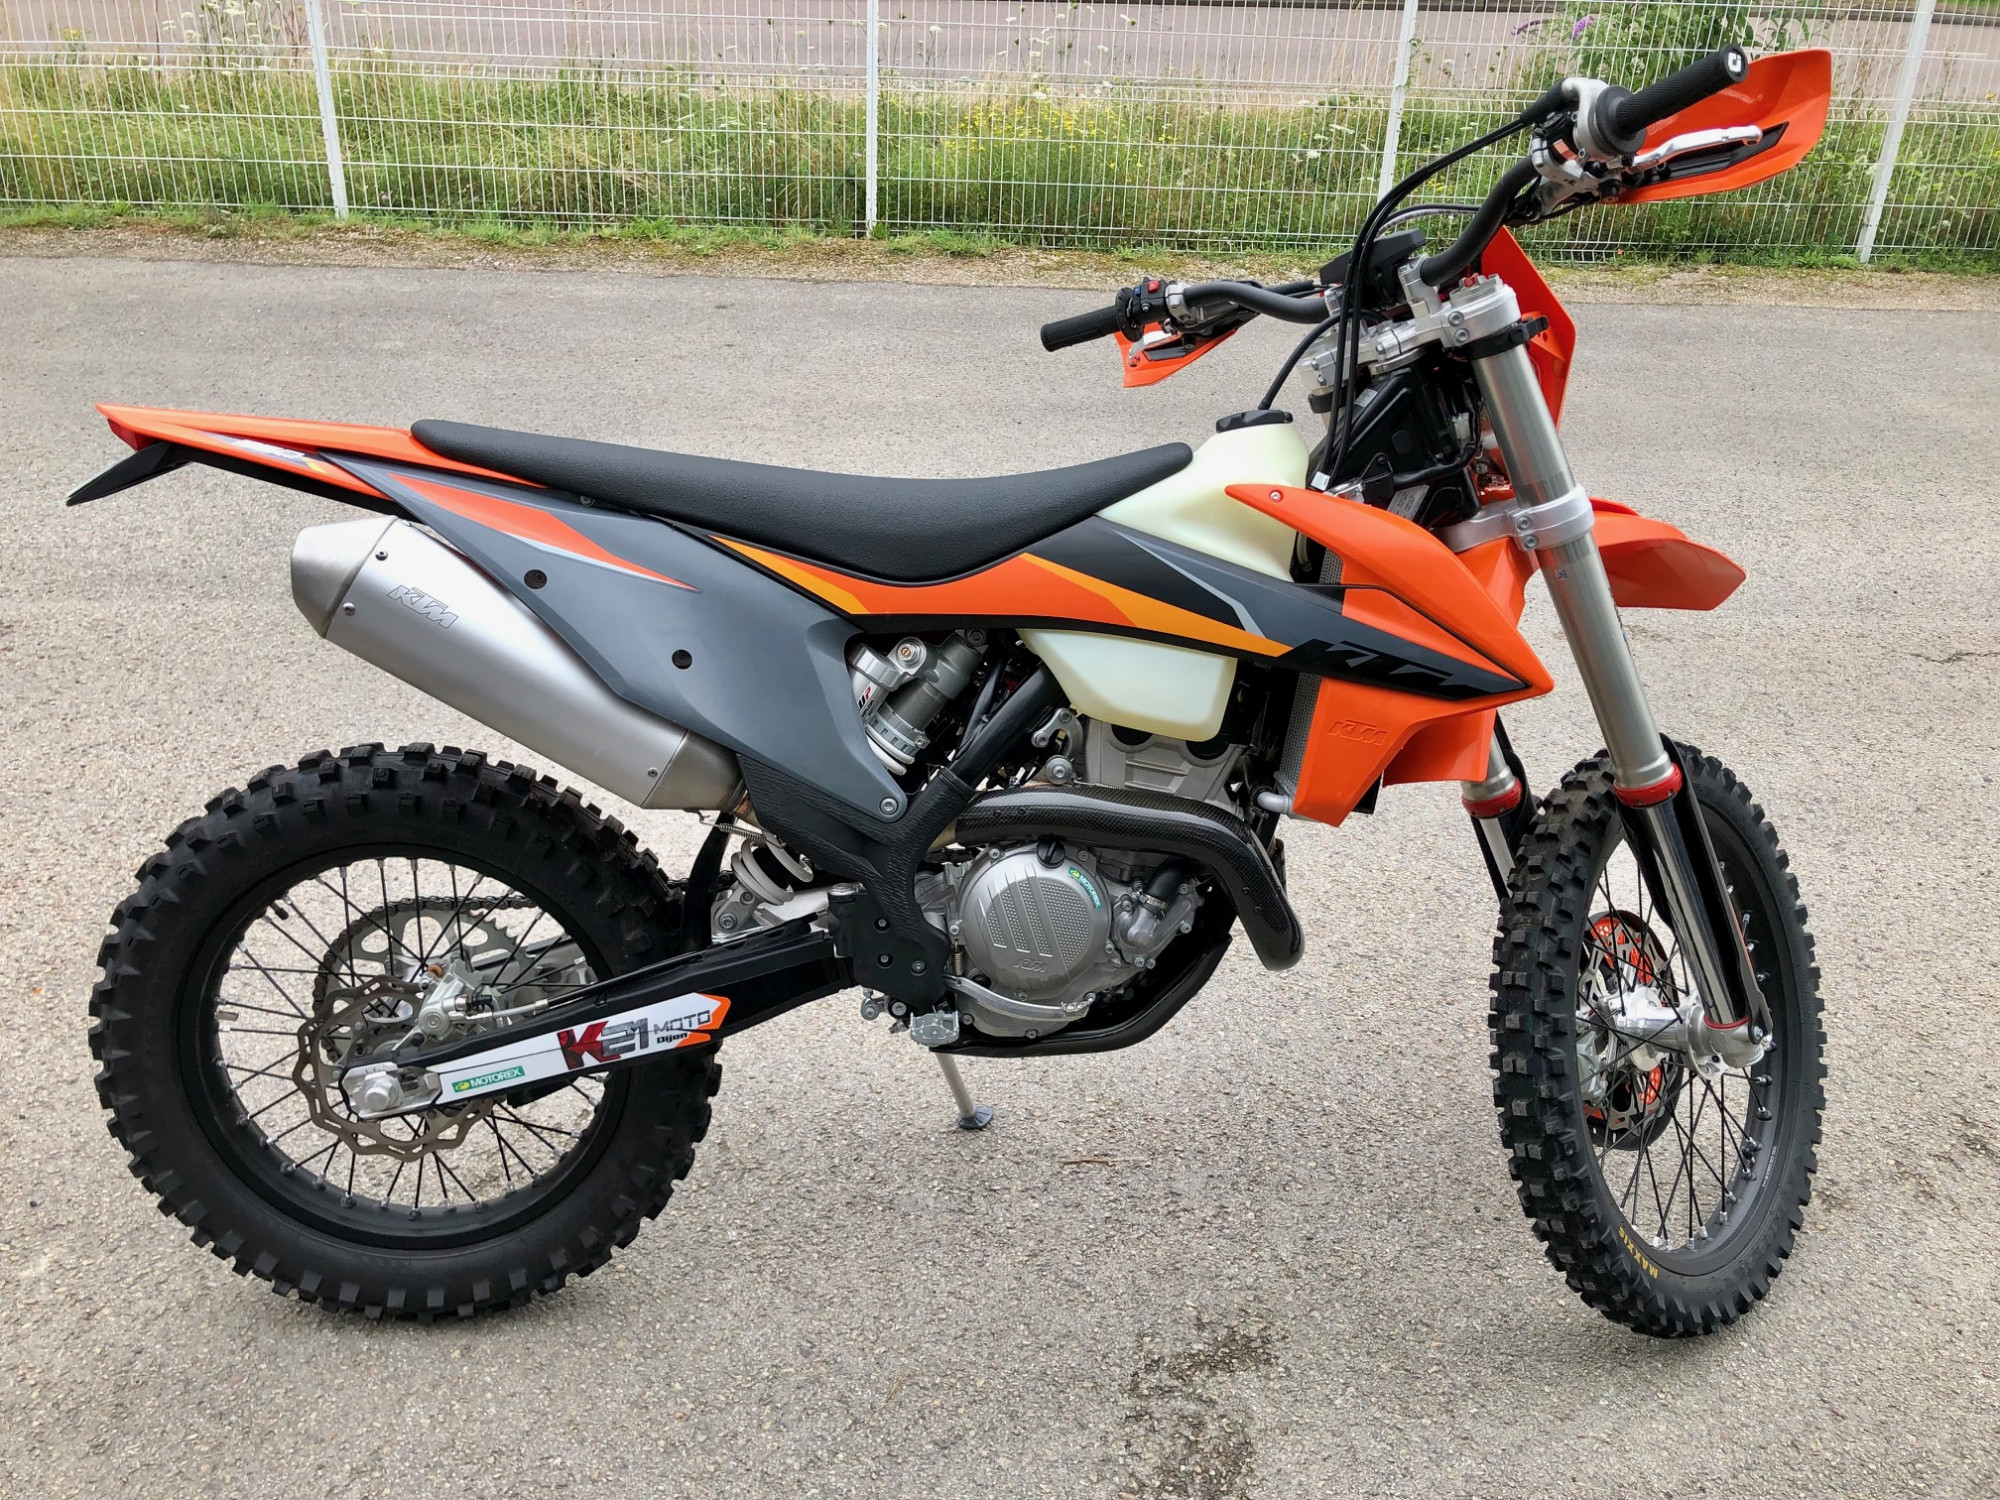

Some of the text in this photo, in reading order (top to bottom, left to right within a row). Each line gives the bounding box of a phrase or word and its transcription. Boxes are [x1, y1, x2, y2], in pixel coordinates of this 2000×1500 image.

[386, 585, 459, 629] KTM
[1328, 719, 1388, 745] KTM
[557, 1010, 710, 1070] K21 MOTO
[656, 1032, 688, 1045] Dijon
[470, 1067, 522, 1088] MOTOREX
[1618, 1226, 1658, 1279] MAXXIS
